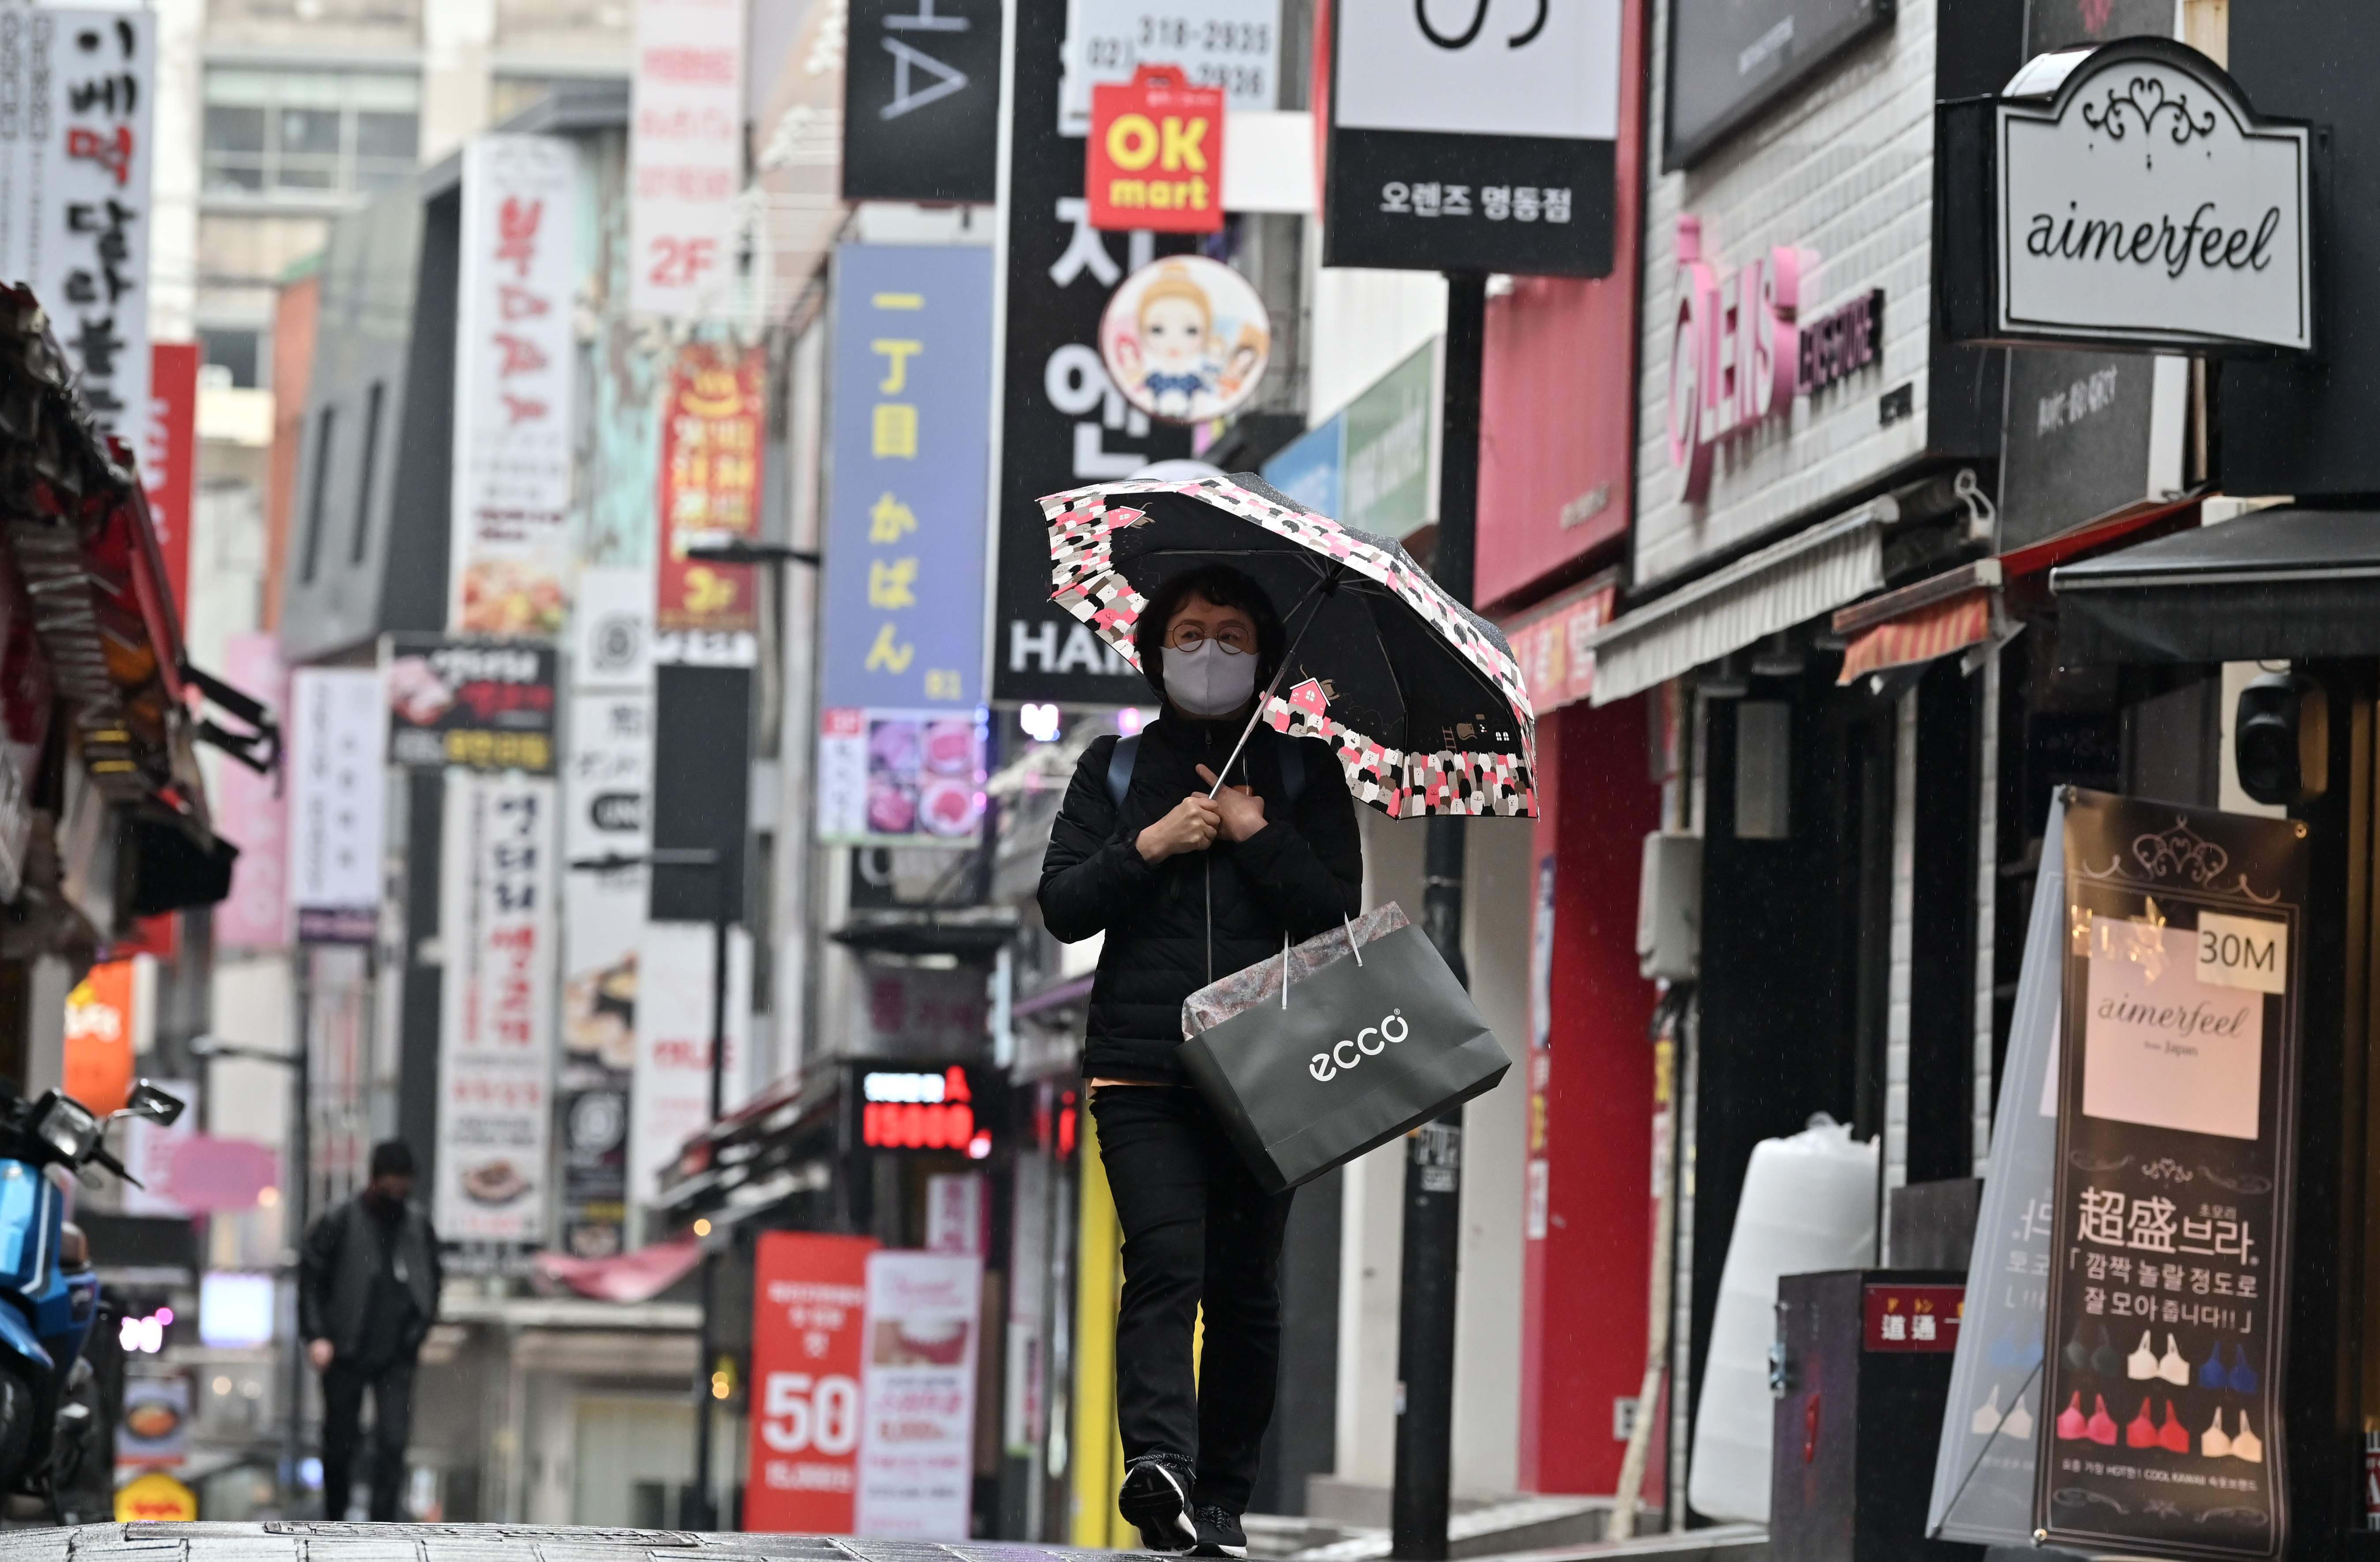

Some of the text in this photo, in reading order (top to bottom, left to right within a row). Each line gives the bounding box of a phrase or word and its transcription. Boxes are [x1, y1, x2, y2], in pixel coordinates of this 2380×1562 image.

[1105, 113, 1209, 173] OK
[1108, 176, 1209, 211] mart
[1380, 181, 1573, 224] 오렌즈 명동점
[648, 234, 721, 288] 2F
[2027, 200, 2281, 279] aimerfeel
[864, 291, 926, 674] 一丁目かばん
[1009, 618, 1138, 676] HAI
[2198, 929, 2276, 973] 30M
[2096, 992, 2251, 1038] aimerfeel
[1309, 1015, 1409, 1082] ecco
[2165, 1039, 2199, 1058] Japan
[2190, 1267, 2259, 1298] 정도로
[762, 1372, 858, 1454] 50
[2143, 1468, 2171, 1484] COOL
